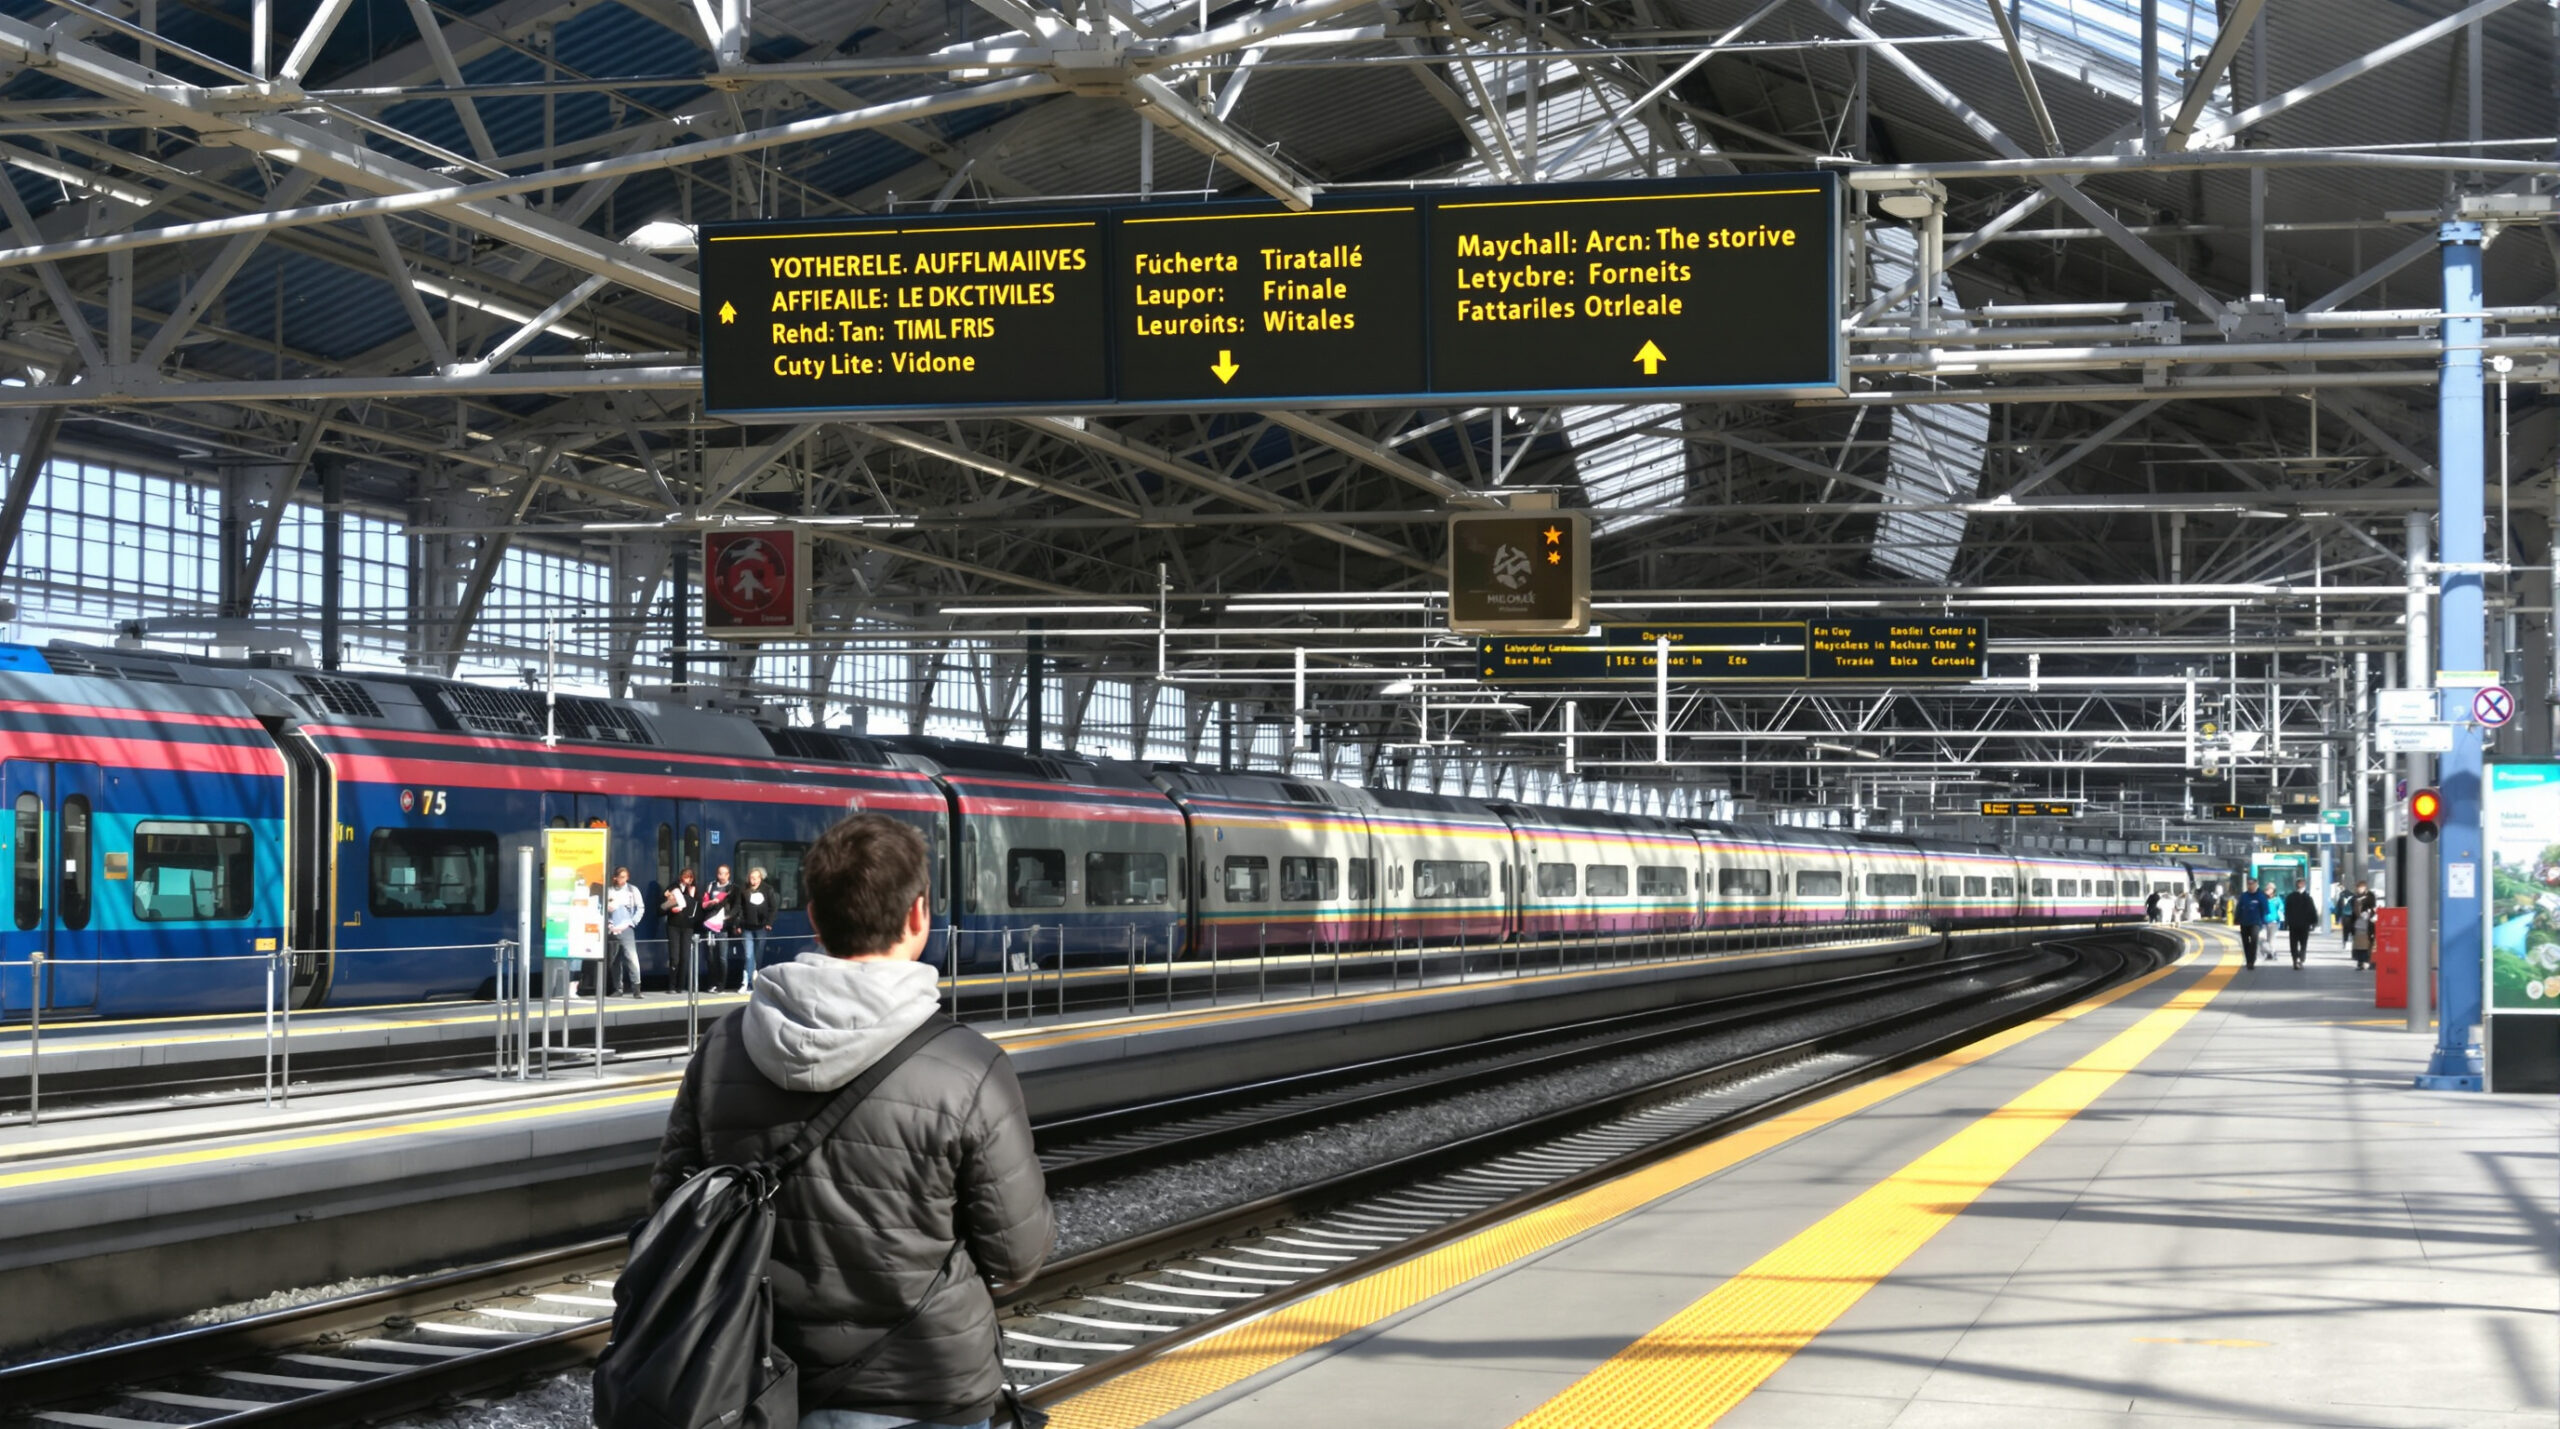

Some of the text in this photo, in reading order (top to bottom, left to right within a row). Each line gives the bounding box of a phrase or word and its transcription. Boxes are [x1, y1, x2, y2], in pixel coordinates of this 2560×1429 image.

[1458, 225, 1795, 261] Maychall: Arcn: The storive
[771, 248, 1086, 278] YOTHERELE. AUFFLMAIIVES
[1260, 245, 1362, 270] Tiratallé
[1458, 260, 1691, 293] Letycbre: Forneits
[772, 283, 1054, 312] AFFIEAILE: LE DKCTIVILES
[1137, 278, 1346, 309] Laupor: Frinale
[1458, 294, 1682, 321] Fattariles Otrleale
[773, 318, 994, 344] Rehd: Tan: TIML FRIS
[1264, 308, 1354, 332] Witales
[774, 355, 825, 379] Cuty
[891, 351, 975, 372] Vidone
[423, 790, 447, 815] 75
